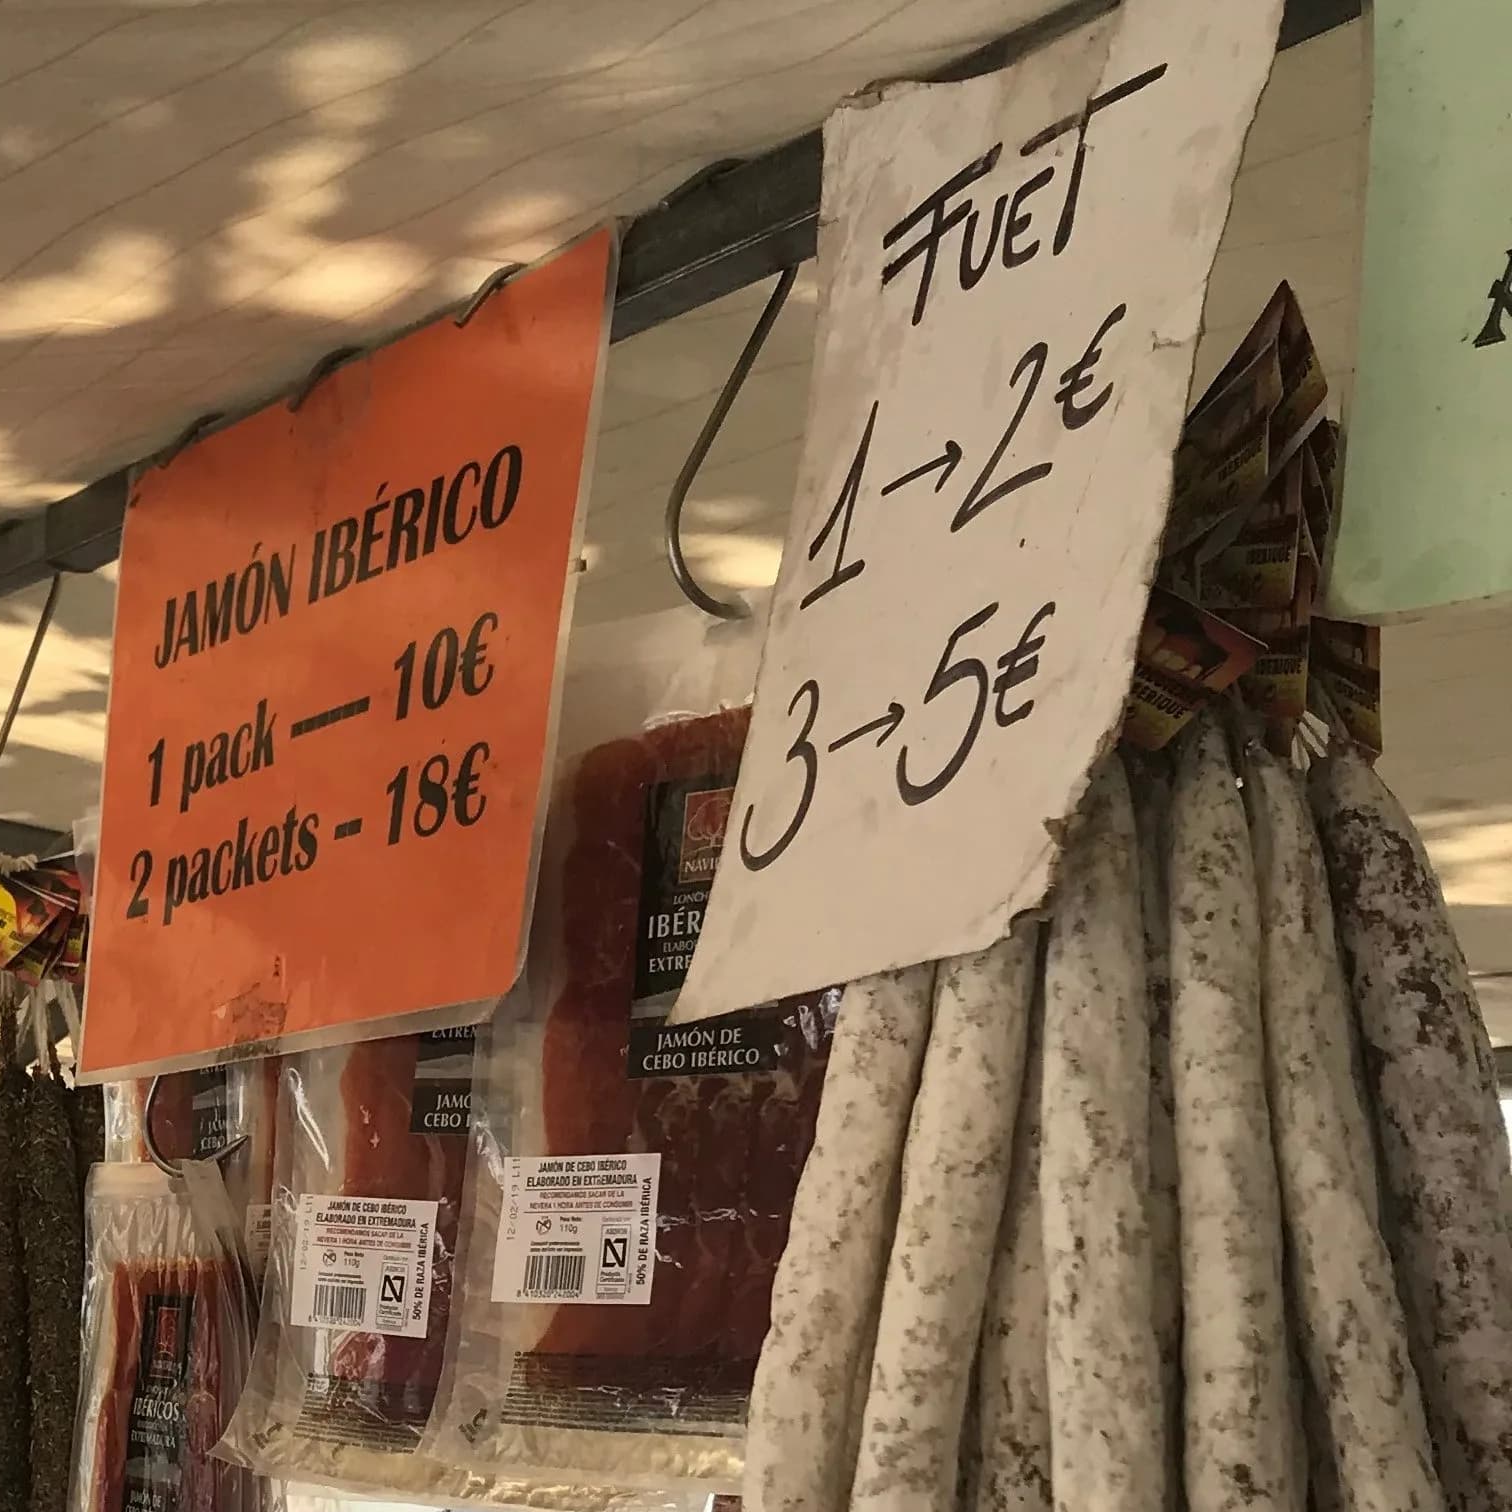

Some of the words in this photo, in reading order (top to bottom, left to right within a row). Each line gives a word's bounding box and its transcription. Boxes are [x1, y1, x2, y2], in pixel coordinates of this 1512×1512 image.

[882, 63, 1167, 325] FUET
[801, 401, 879, 609] 1
[155, 543, 296, 669] JAMÓN
[308, 445, 523, 605] IBÉRICO
[148, 738, 166, 807] 1
[180, 698, 278, 813] pack
[394, 612, 498, 722] 10€
[740, 680, 820, 871] 3
[126, 850, 154, 920] 2
[163, 805, 320, 926] packets
[386, 741, 490, 846] 18€
[657, 1026, 715, 1052] JAMÓN
[720, 1028, 742, 1045] DE
[643, 1053, 685, 1071] CEBO
[691, 1047, 760, 1068] IBÉRICO
[424, 1112, 461, 1128] CEBO
[538, 1160, 564, 1173] JAMÓN
[565, 1162, 575, 1172] DE
[577, 1161, 596, 1171] CEBO
[598, 1158, 627, 1171] IBÉRICO
[527, 1176, 570, 1187] ELABORADO
[572, 1176, 582, 1186] EN
[584, 1174, 637, 1186] EXTREMADURA
[641, 1177, 652, 1216] IBÉRICA
[640, 1219, 650, 1246] RAZA
[638, 1247, 649, 1262] DE
[635, 1263, 646, 1286] 50%
